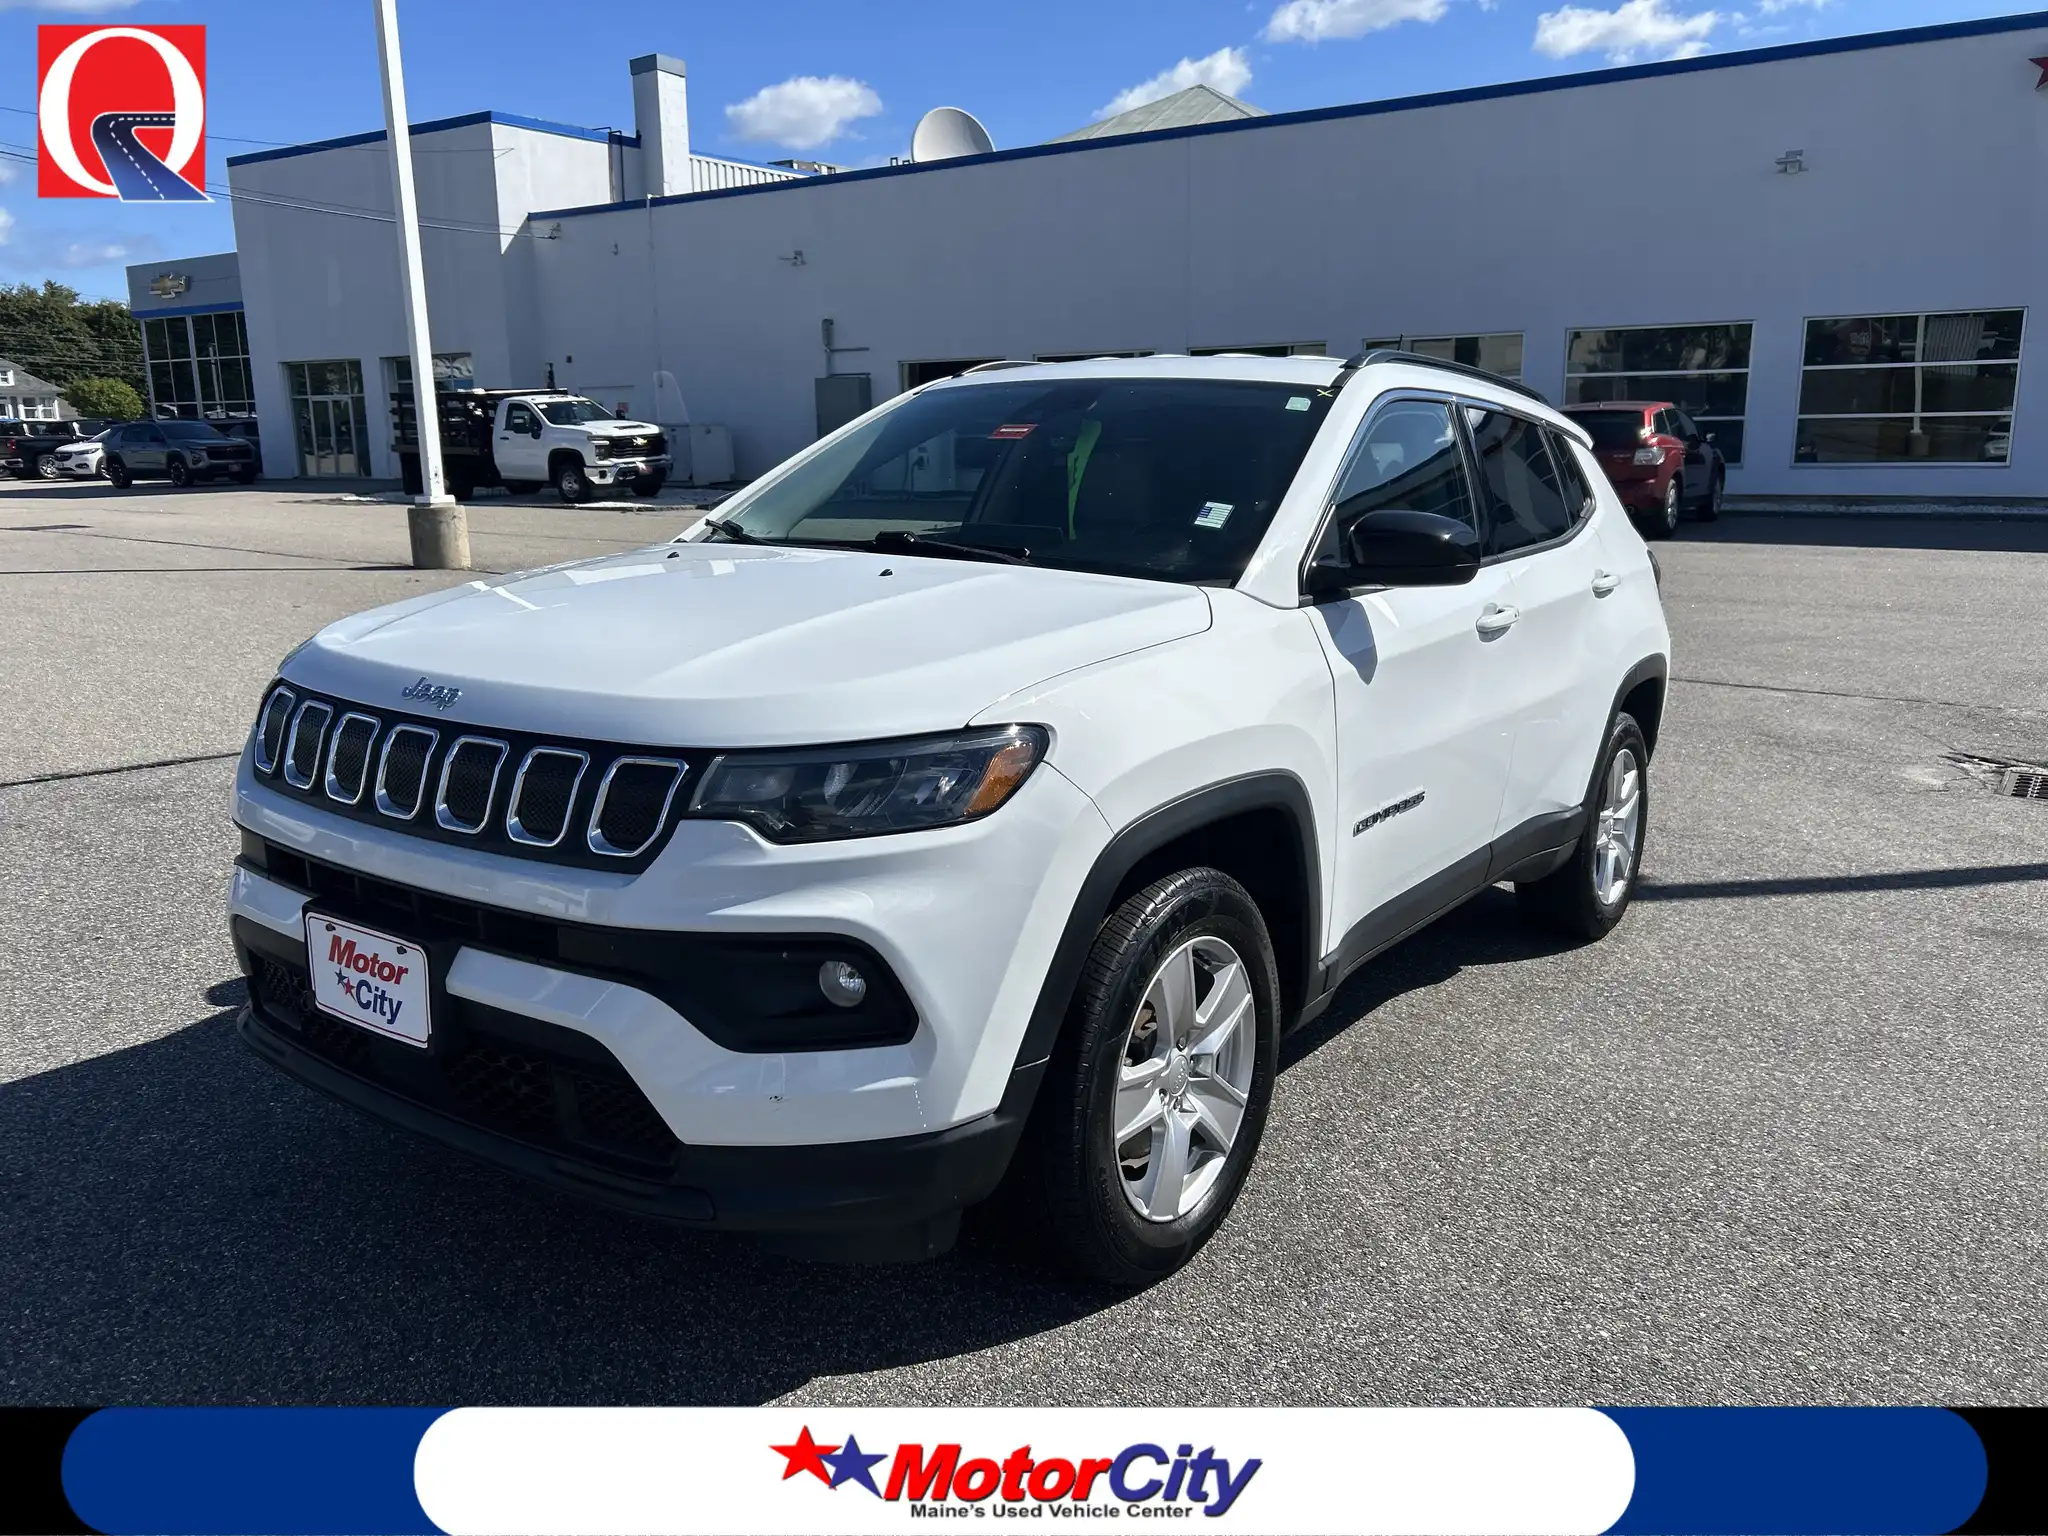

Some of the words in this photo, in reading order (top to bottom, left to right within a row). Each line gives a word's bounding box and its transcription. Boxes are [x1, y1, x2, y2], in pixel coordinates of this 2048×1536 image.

[402, 676, 463, 711] Jeep
[1352, 791, 1425, 837] COMPASS
[328, 934, 409, 985] Motor
[355, 979, 403, 1025] City
